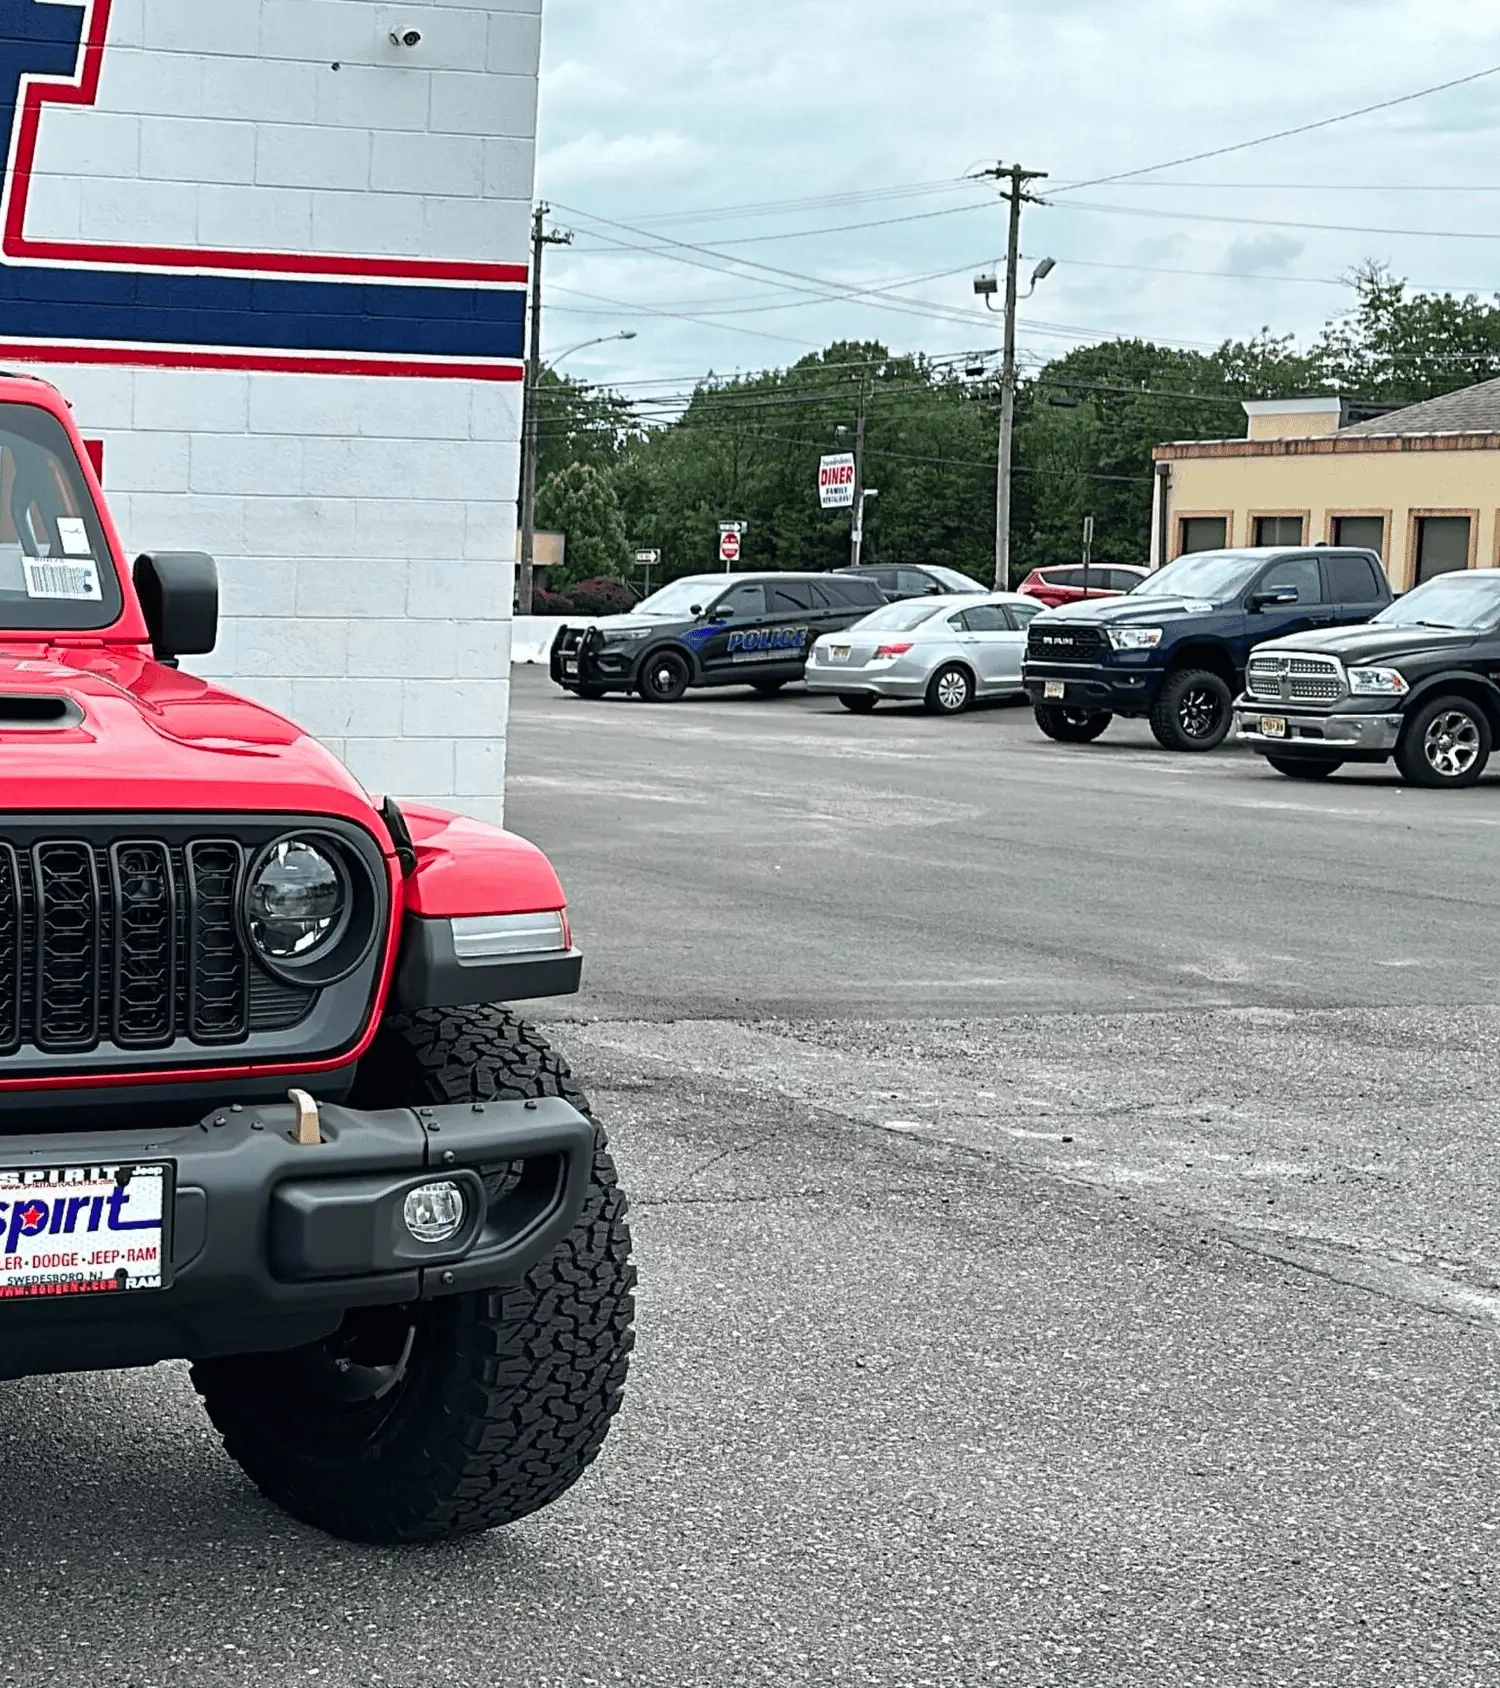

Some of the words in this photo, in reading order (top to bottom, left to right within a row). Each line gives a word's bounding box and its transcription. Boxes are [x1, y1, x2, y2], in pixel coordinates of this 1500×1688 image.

[821, 466, 853, 486] DINER
[727, 626, 808, 652] POLICE
[1043, 636, 1073, 645] RAM
[131, 1164, 163, 1177] Jeep
[32, 1252, 78, 1269] DODGE
[87, 1250, 120, 1265] JEEP
[127, 1247, 157, 1262] RAM
[89, 1271, 103, 1281] NJ
[125, 1276, 162, 1290] RAM
